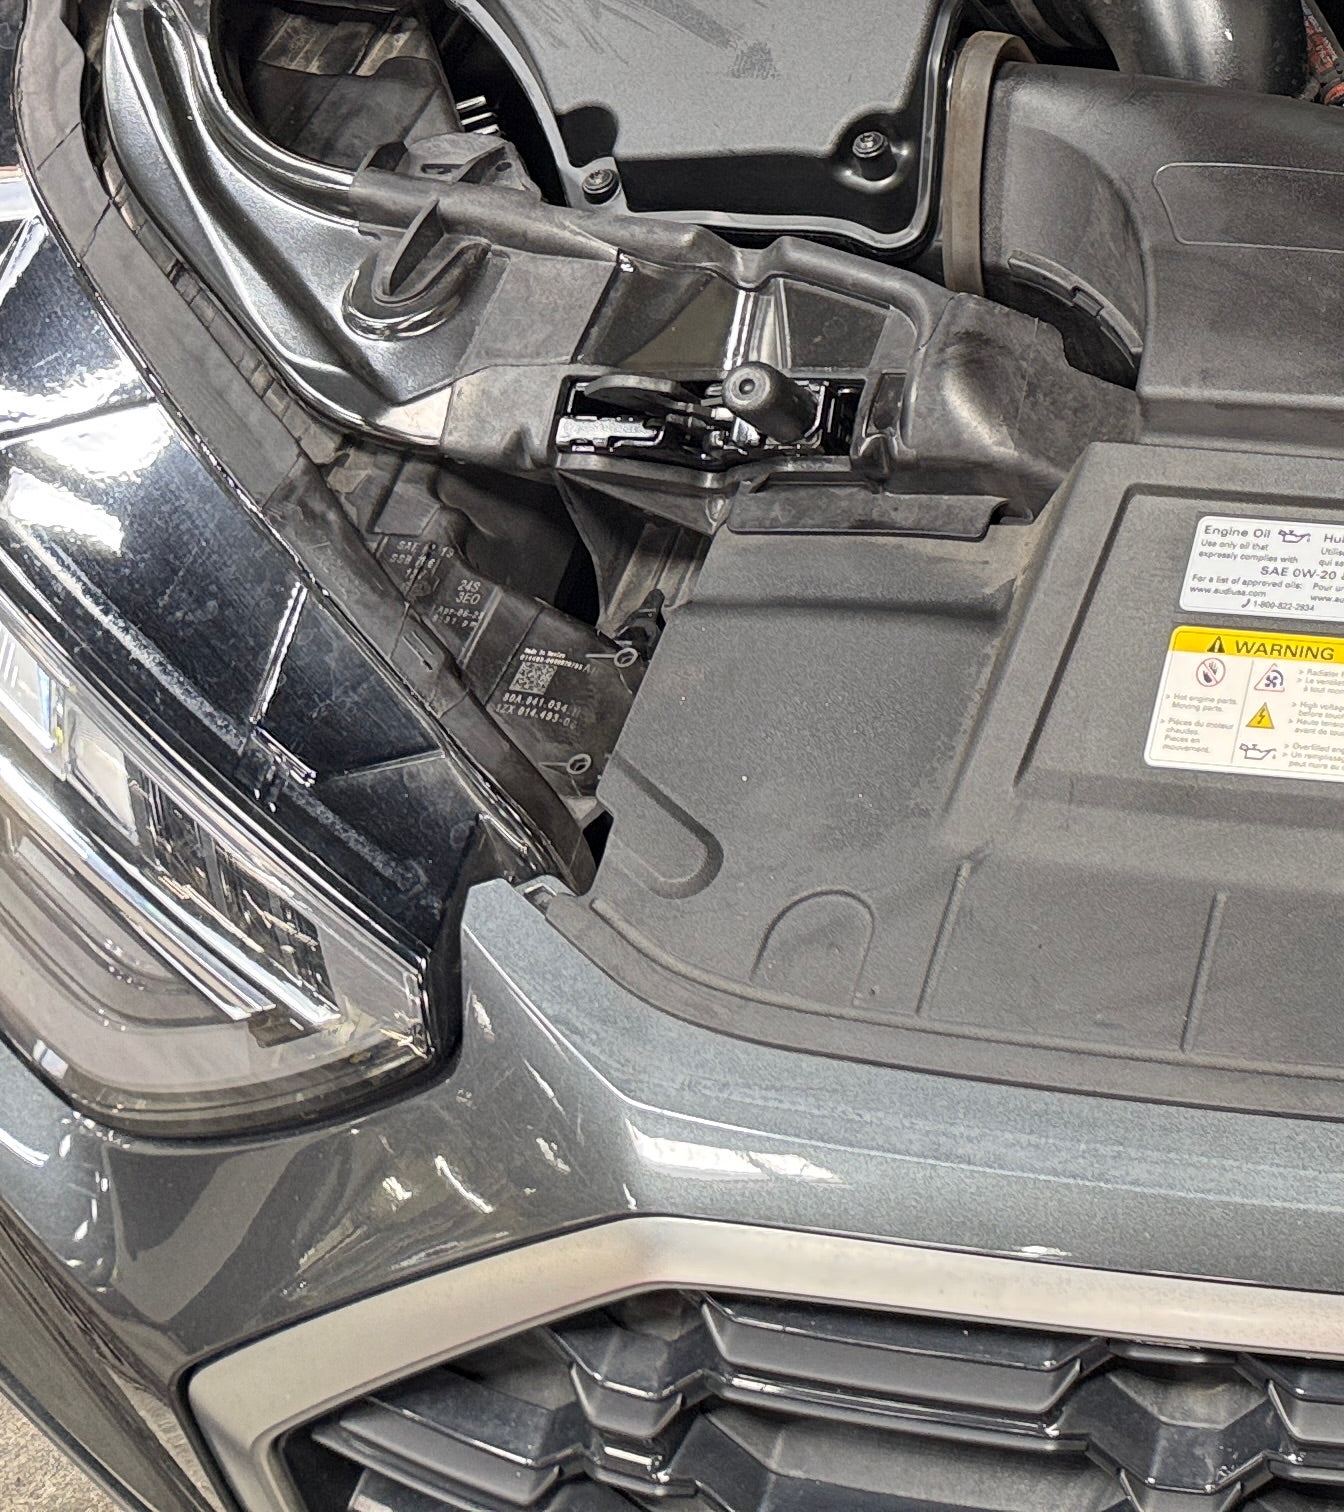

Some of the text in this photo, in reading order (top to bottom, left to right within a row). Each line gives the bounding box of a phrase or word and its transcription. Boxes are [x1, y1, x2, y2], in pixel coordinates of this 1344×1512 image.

[1204, 525, 1272, 538] Engine Oil
[1201, 539, 1269, 551] Use only oil that
[1198, 551, 1298, 563] expressly complies with
[1318, 559, 1332, 568] qui
[1260, 565, 1290, 577] SAE
[1292, 568, 1337, 580] 0W-20
[457, 579, 481, 593] 24S
[1192, 574, 1207, 583] For
[1216, 574, 1229, 584] list
[1231, 576, 1240, 585] of
[1241, 578, 1283, 589] approved
[1312, 583, 1333, 592] Pour
[1189, 586, 1267, 597] www.audiusa.com
[1235, 640, 1334, 661] WARNING
